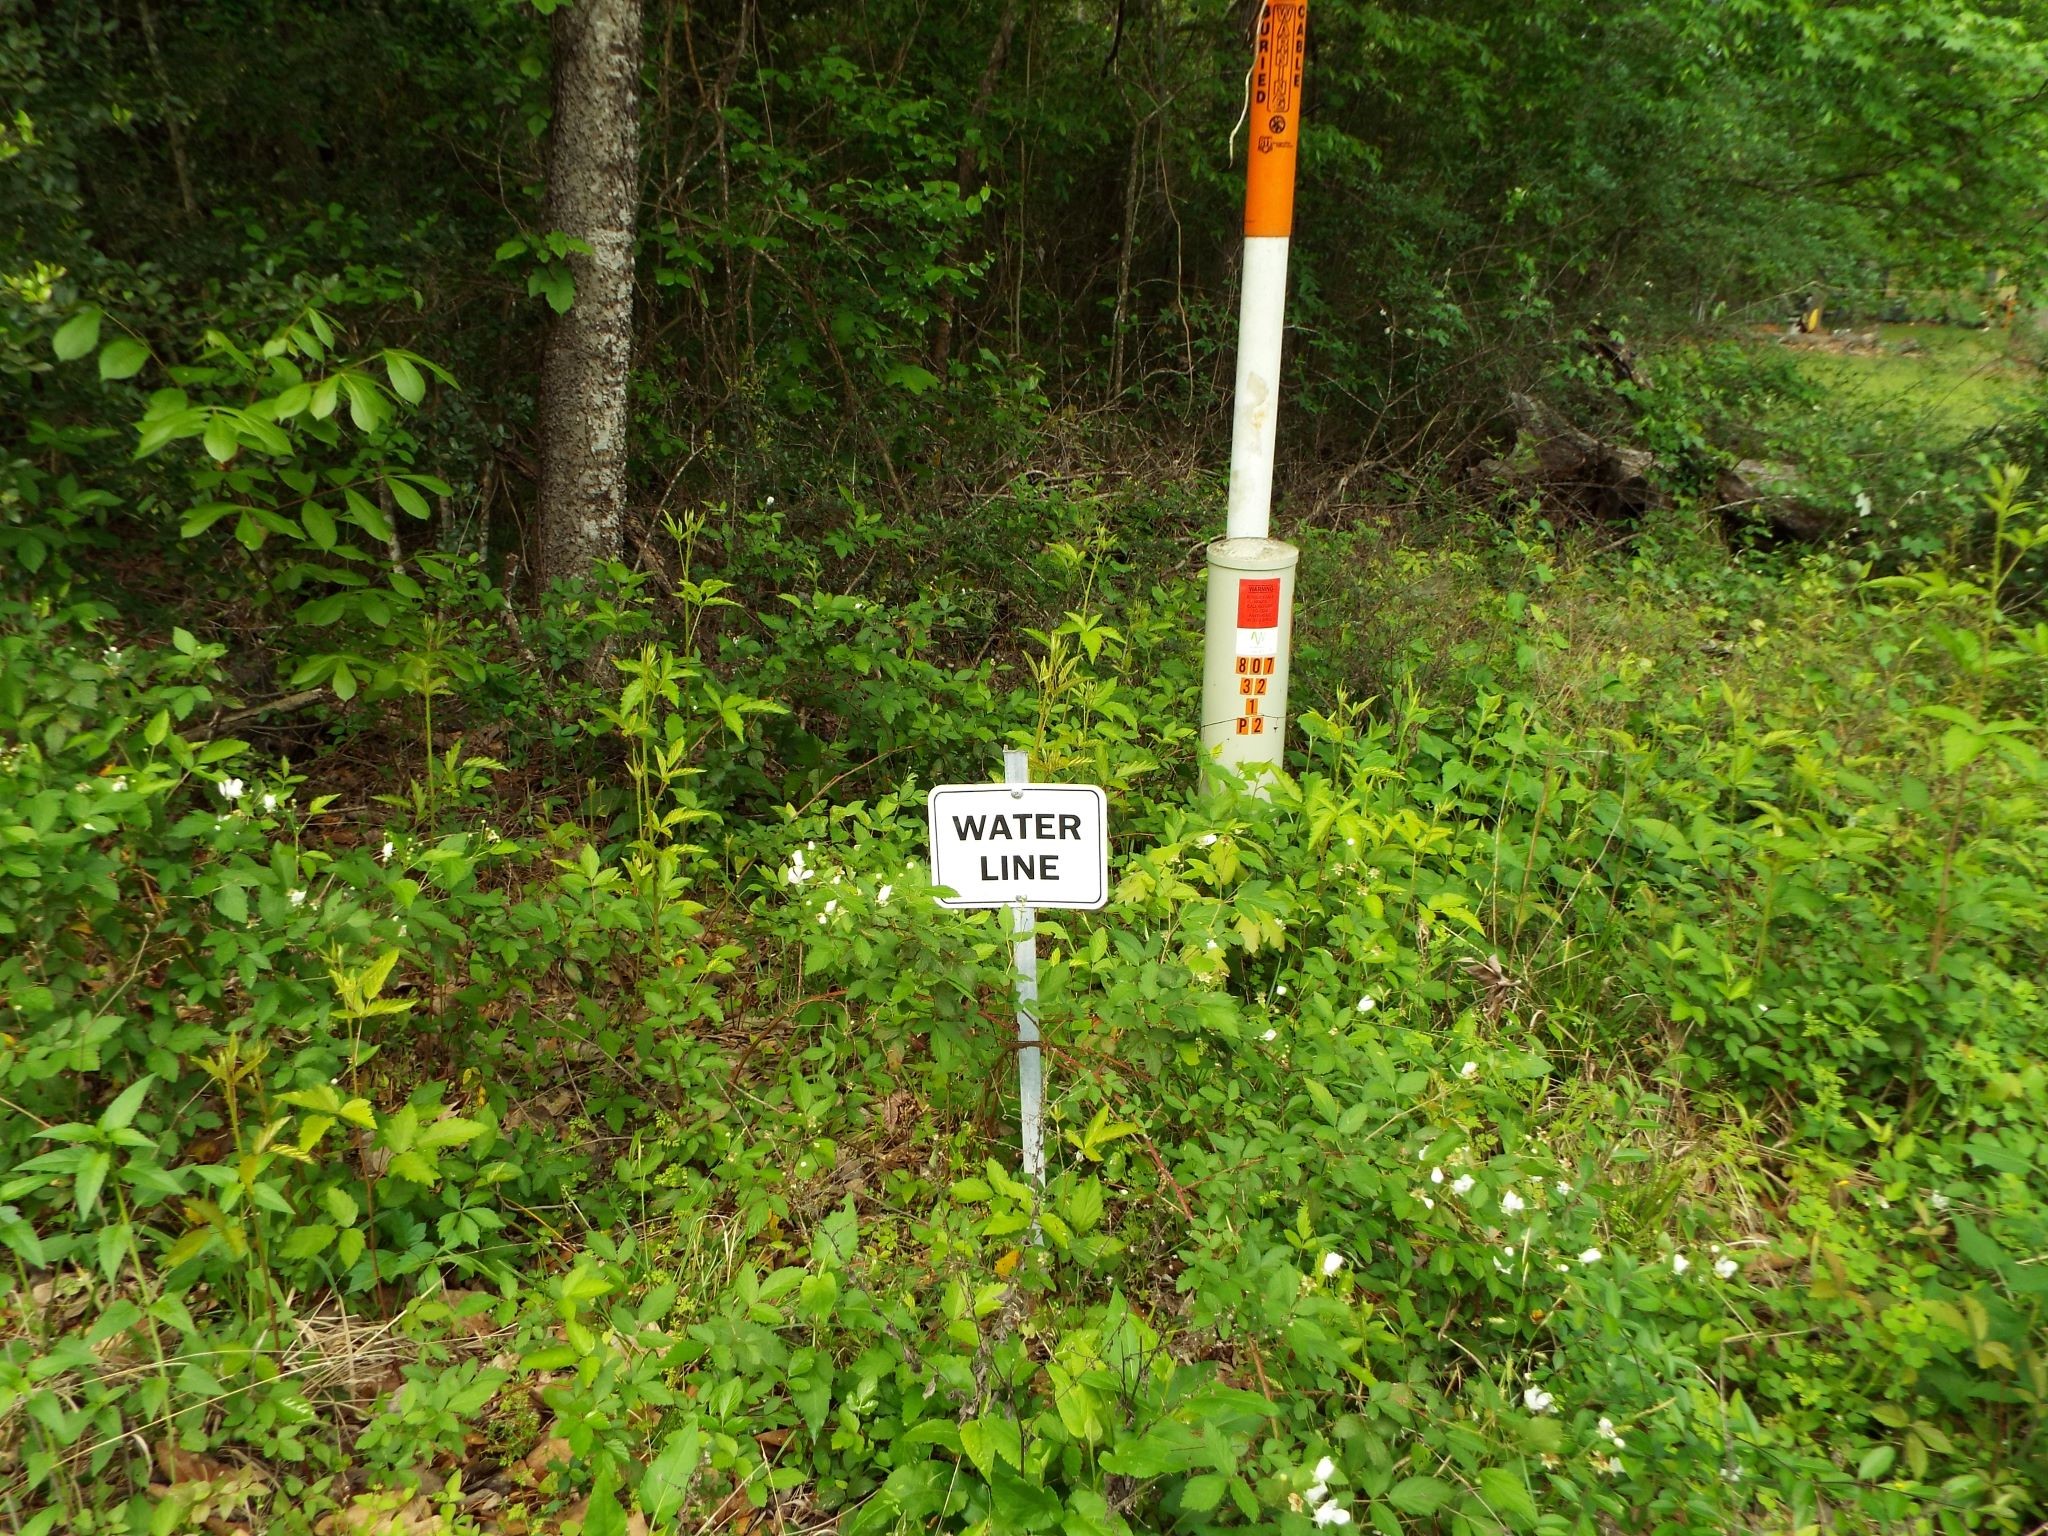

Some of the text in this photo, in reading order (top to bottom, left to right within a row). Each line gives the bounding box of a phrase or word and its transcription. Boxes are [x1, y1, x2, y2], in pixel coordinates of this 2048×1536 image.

[1272, 5, 1295, 112] WARNING
[1294, 5, 1305, 87] CABLE
[1239, 657, 1273, 673] 807
[1243, 679, 1265, 693] 32
[952, 813, 1082, 841] WATER
[980, 855, 1060, 881] LINE
